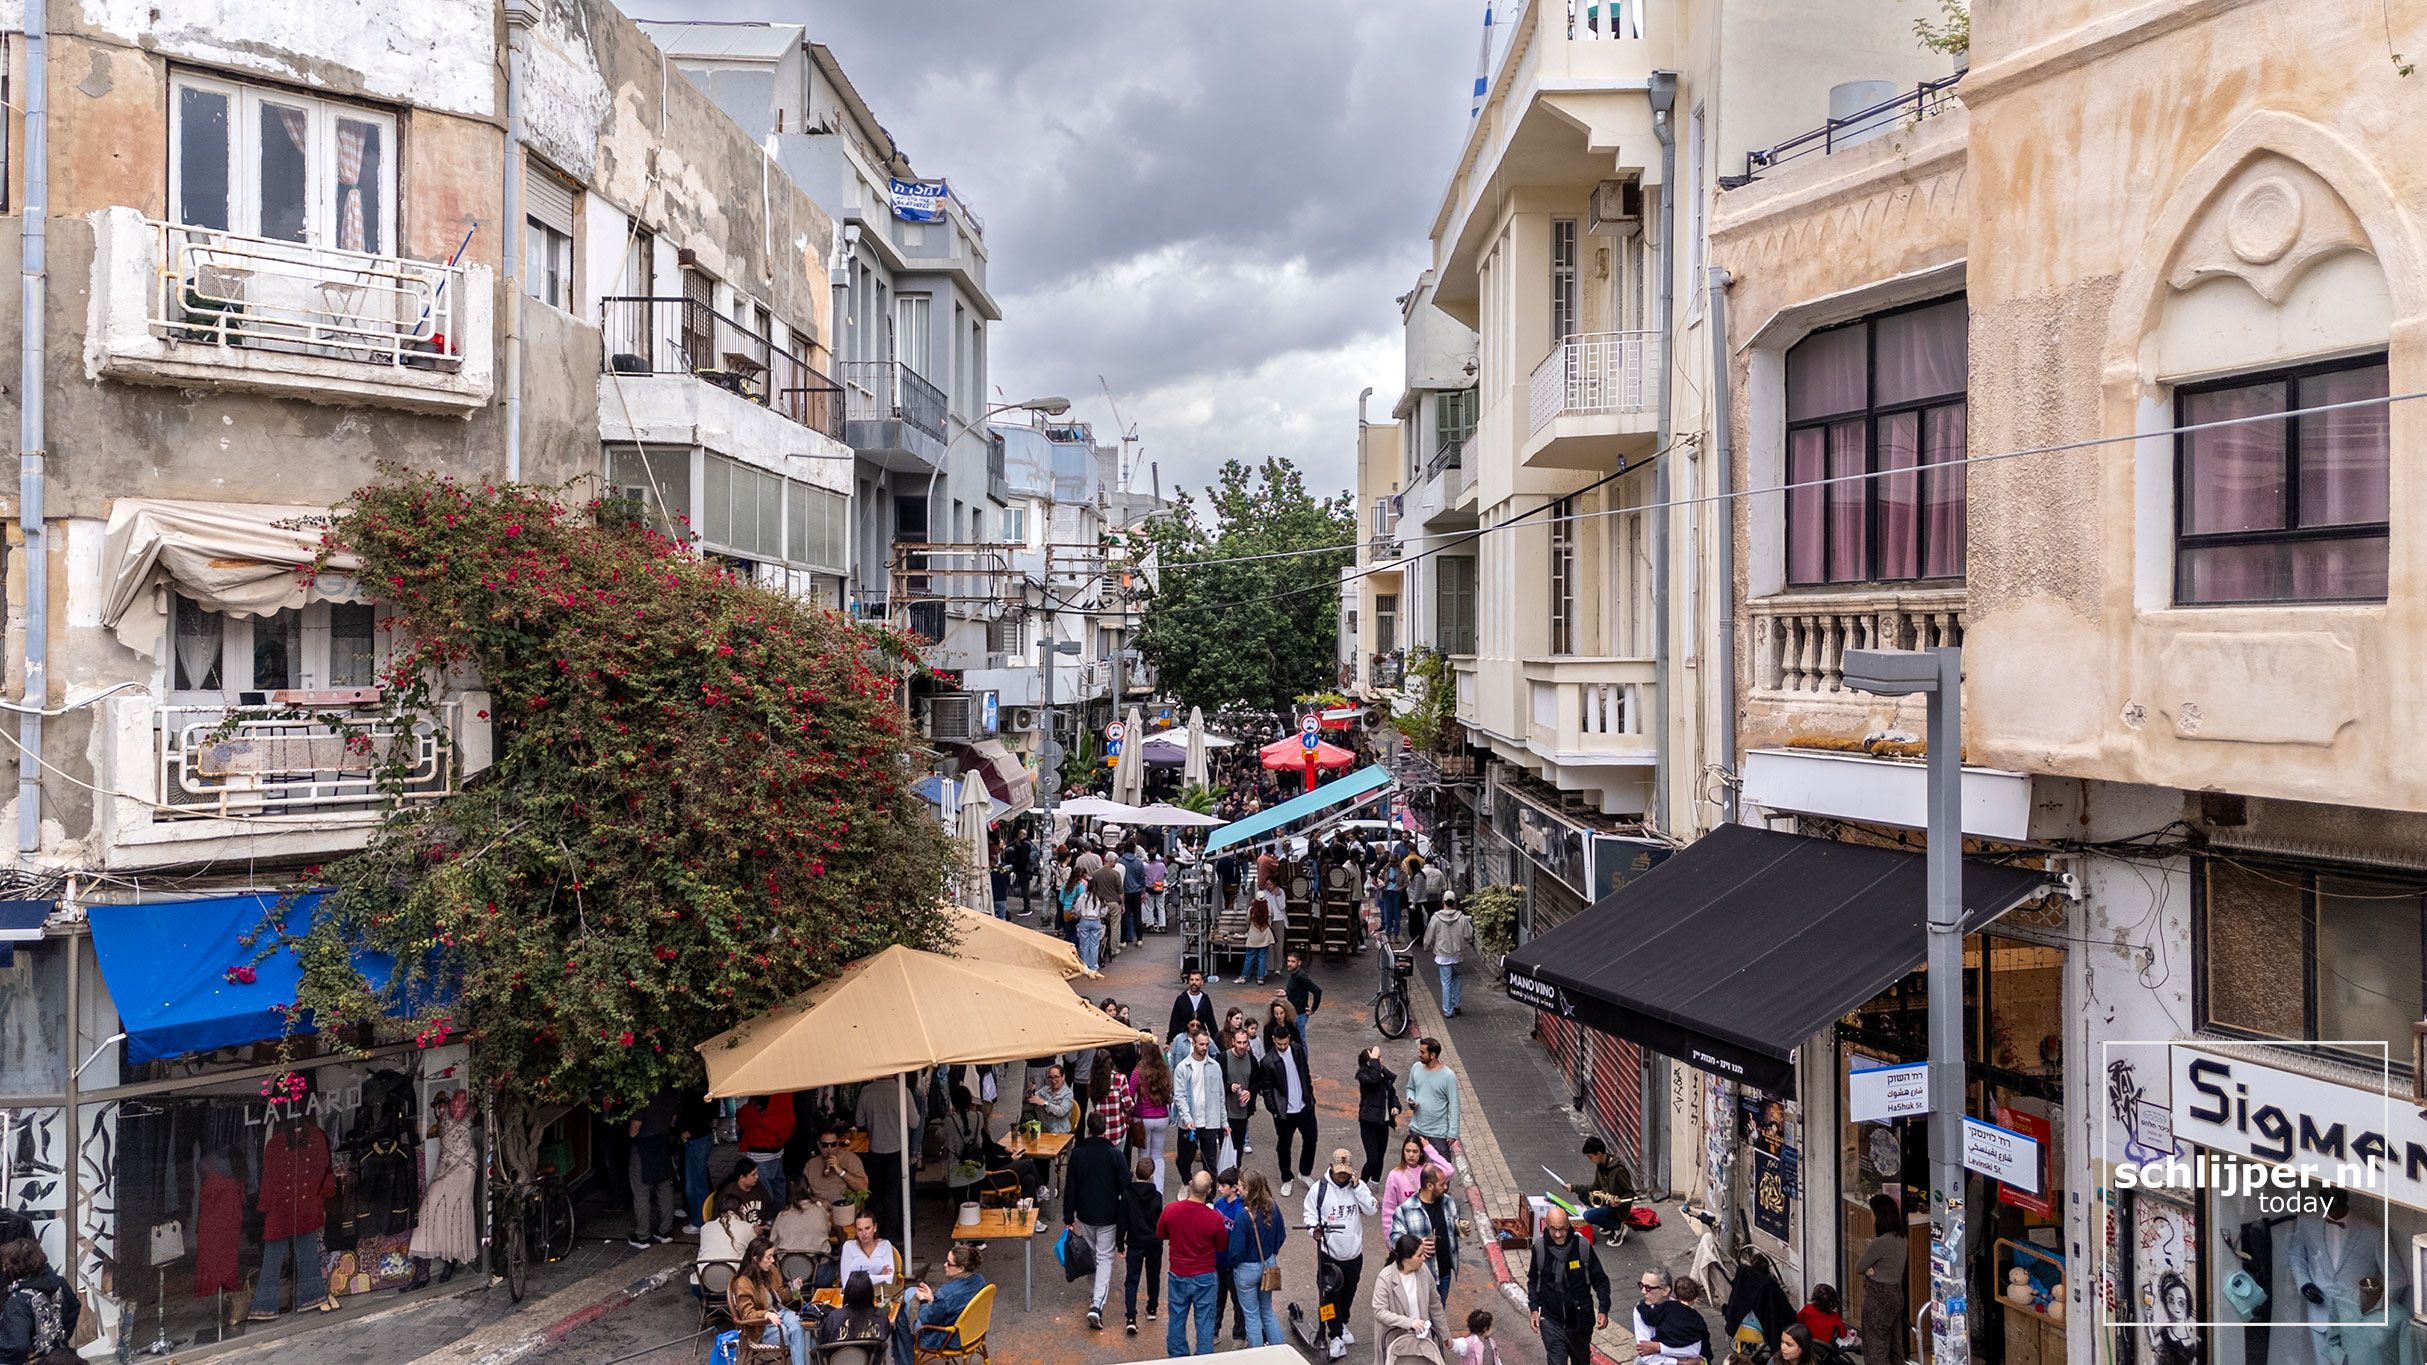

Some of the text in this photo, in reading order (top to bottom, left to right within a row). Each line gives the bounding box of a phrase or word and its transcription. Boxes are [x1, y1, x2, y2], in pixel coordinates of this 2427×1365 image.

[1510, 972, 1555, 999] MANO VINO
[1887, 1073, 1910, 1085] השוק
[1887, 1101, 1914, 1112] HaShuk
[1968, 1126, 1997, 1142] לוינסקי
[1967, 1155, 1993, 1171] Levinski
